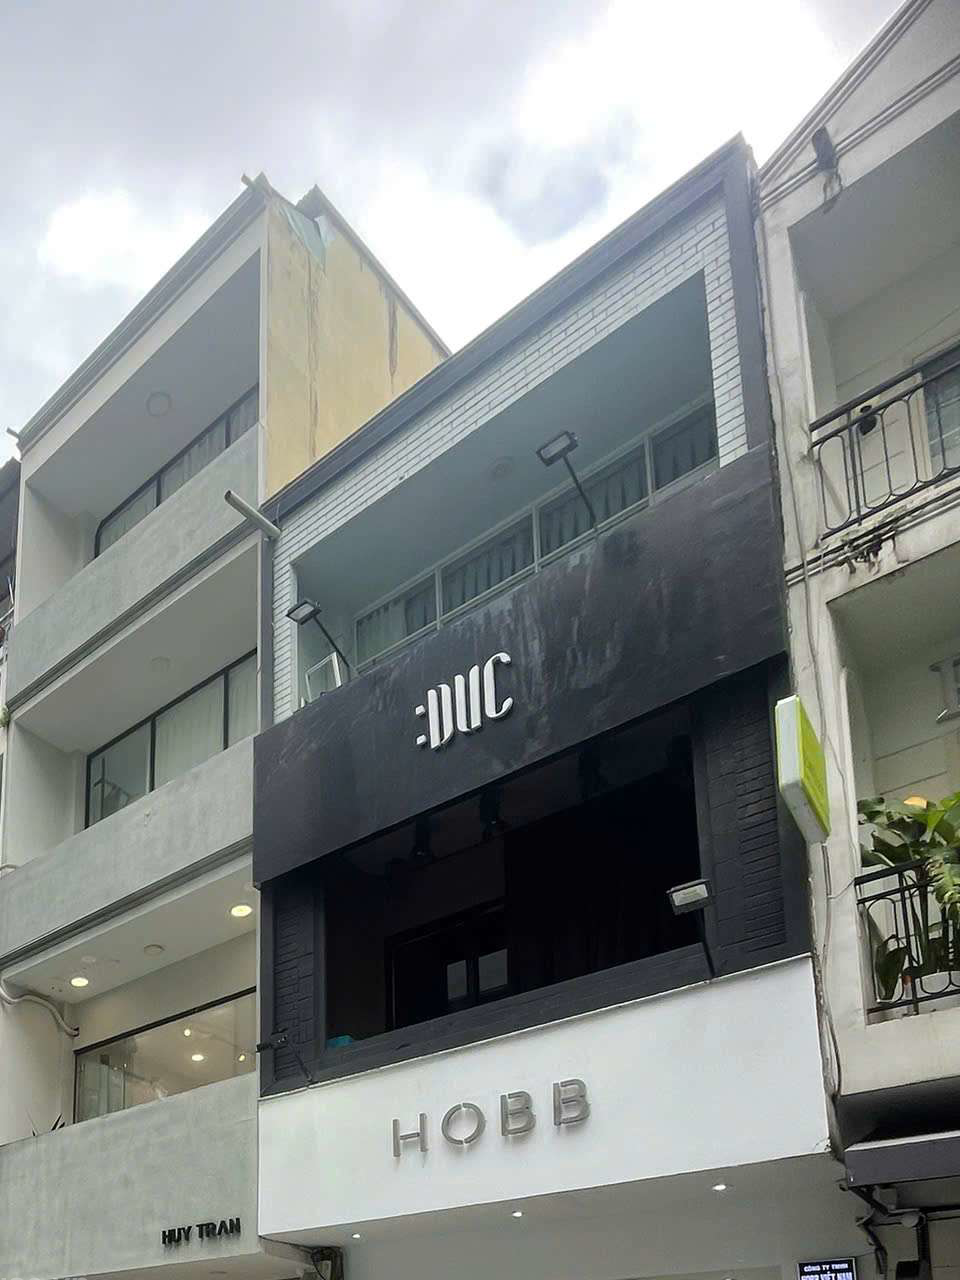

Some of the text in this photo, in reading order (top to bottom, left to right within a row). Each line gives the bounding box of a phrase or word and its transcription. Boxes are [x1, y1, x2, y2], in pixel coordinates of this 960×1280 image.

[392, 1078, 591, 1158] HOBB
[161, 1217, 241, 1245] HUY TRAN
